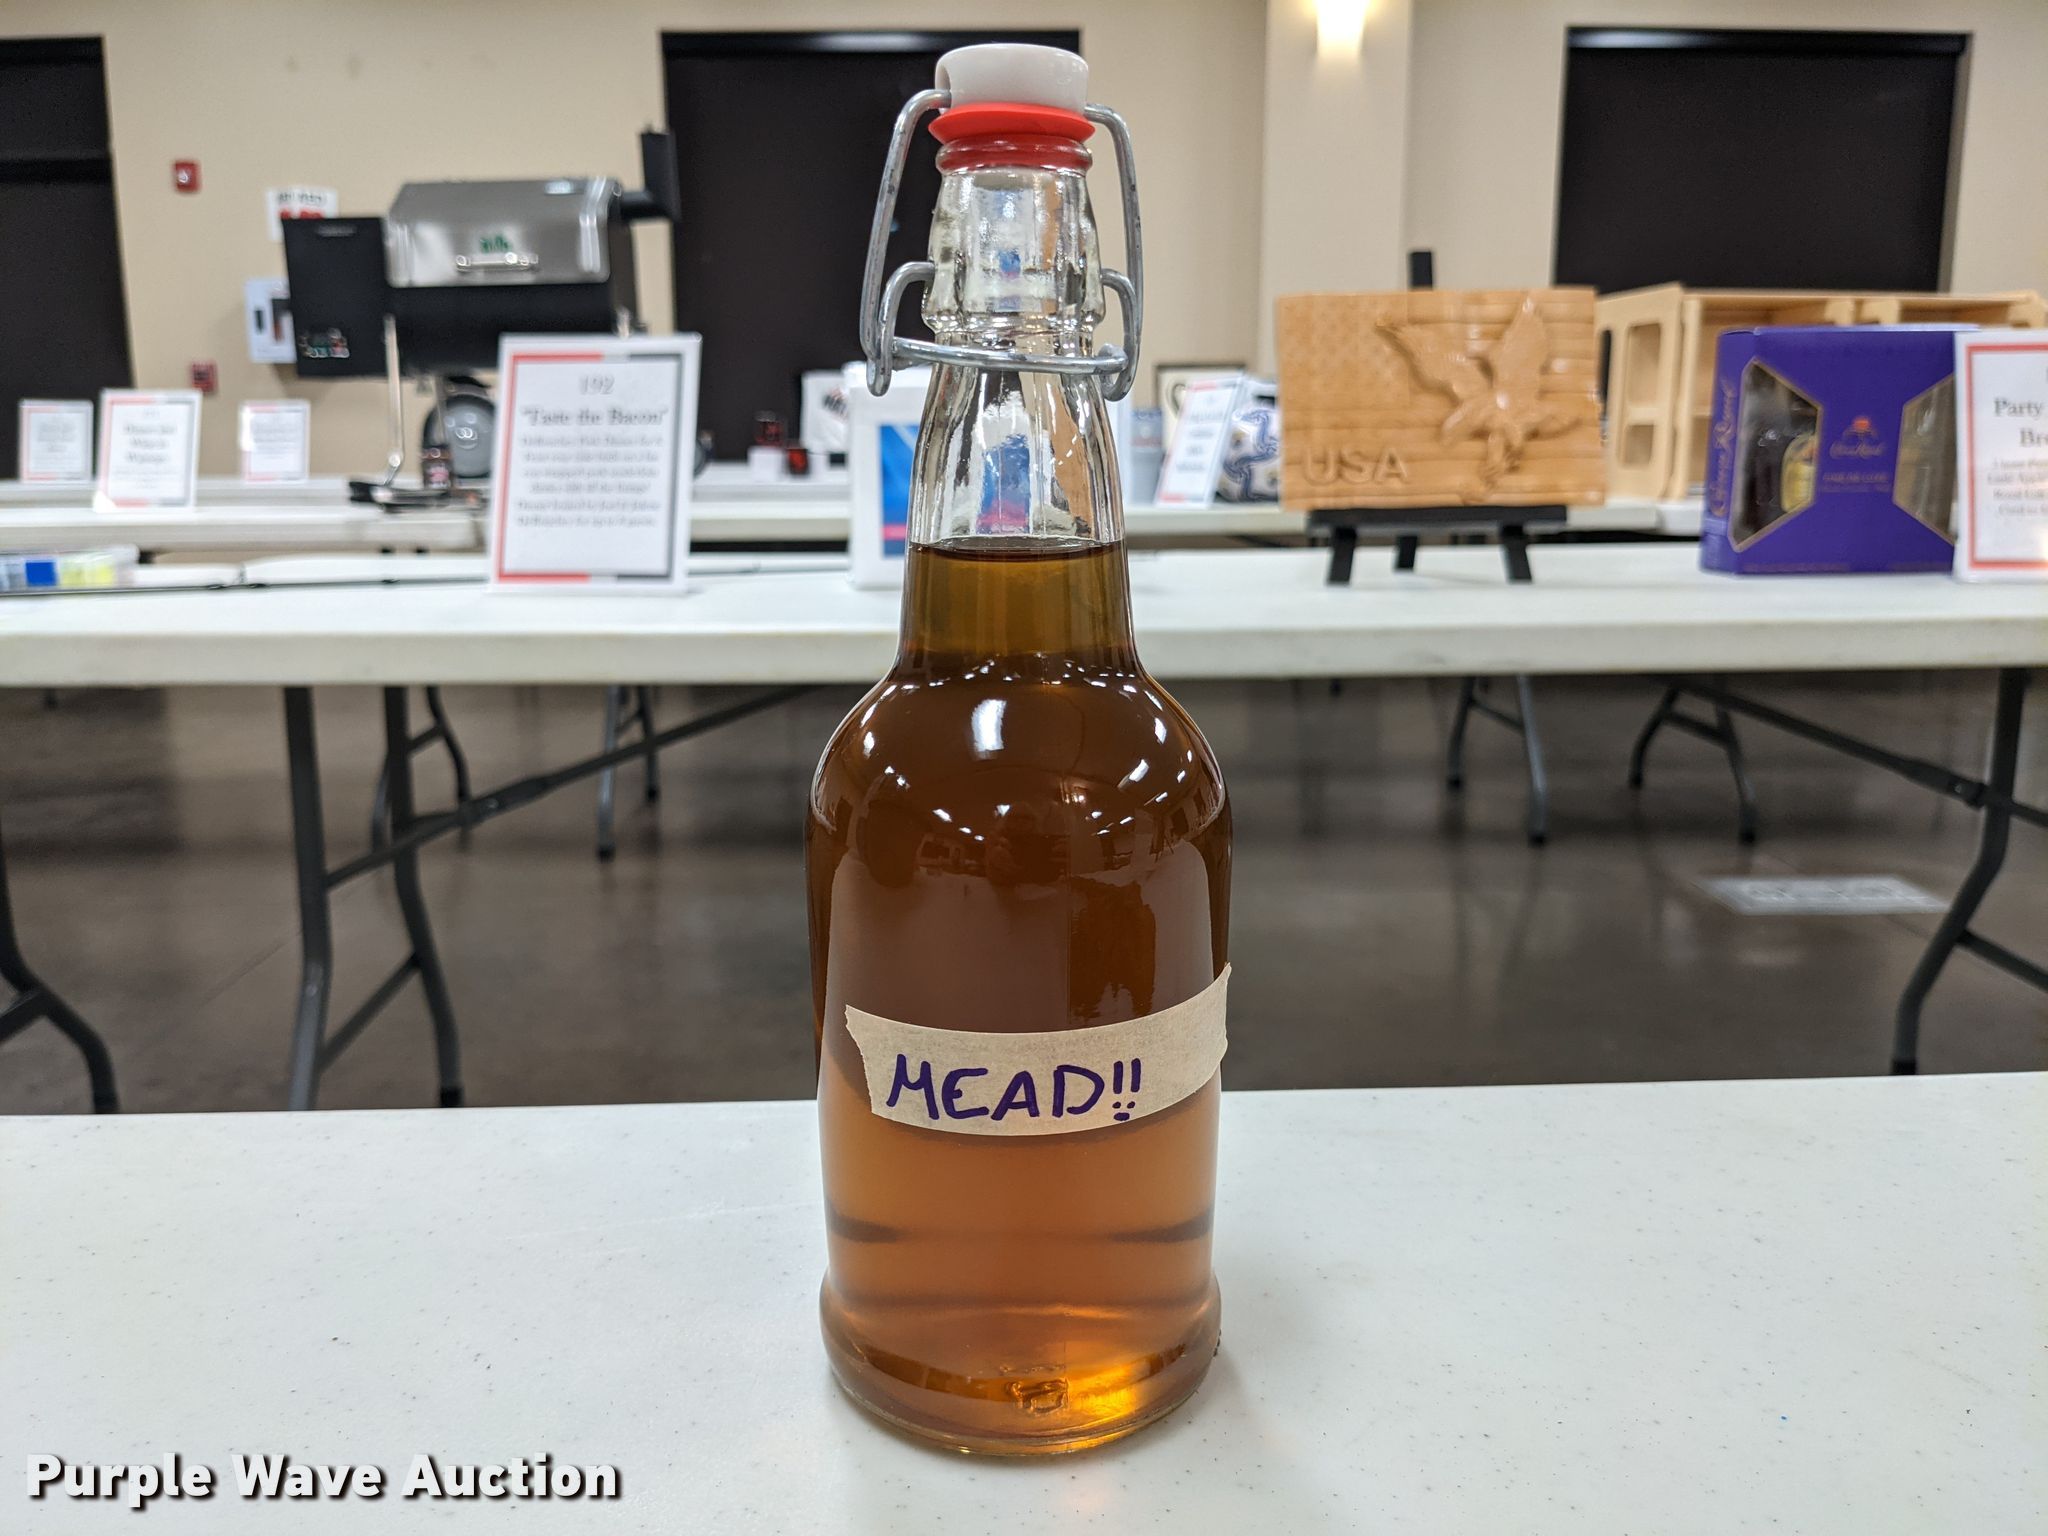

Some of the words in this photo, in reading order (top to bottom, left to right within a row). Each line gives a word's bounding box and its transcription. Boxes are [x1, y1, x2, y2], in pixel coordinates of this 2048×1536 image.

[576, 407, 603, 426] the
[1994, 398, 2043, 421] Party
[1302, 446, 1410, 486] USA
[885, 1053, 1142, 1122] MEAD!!
